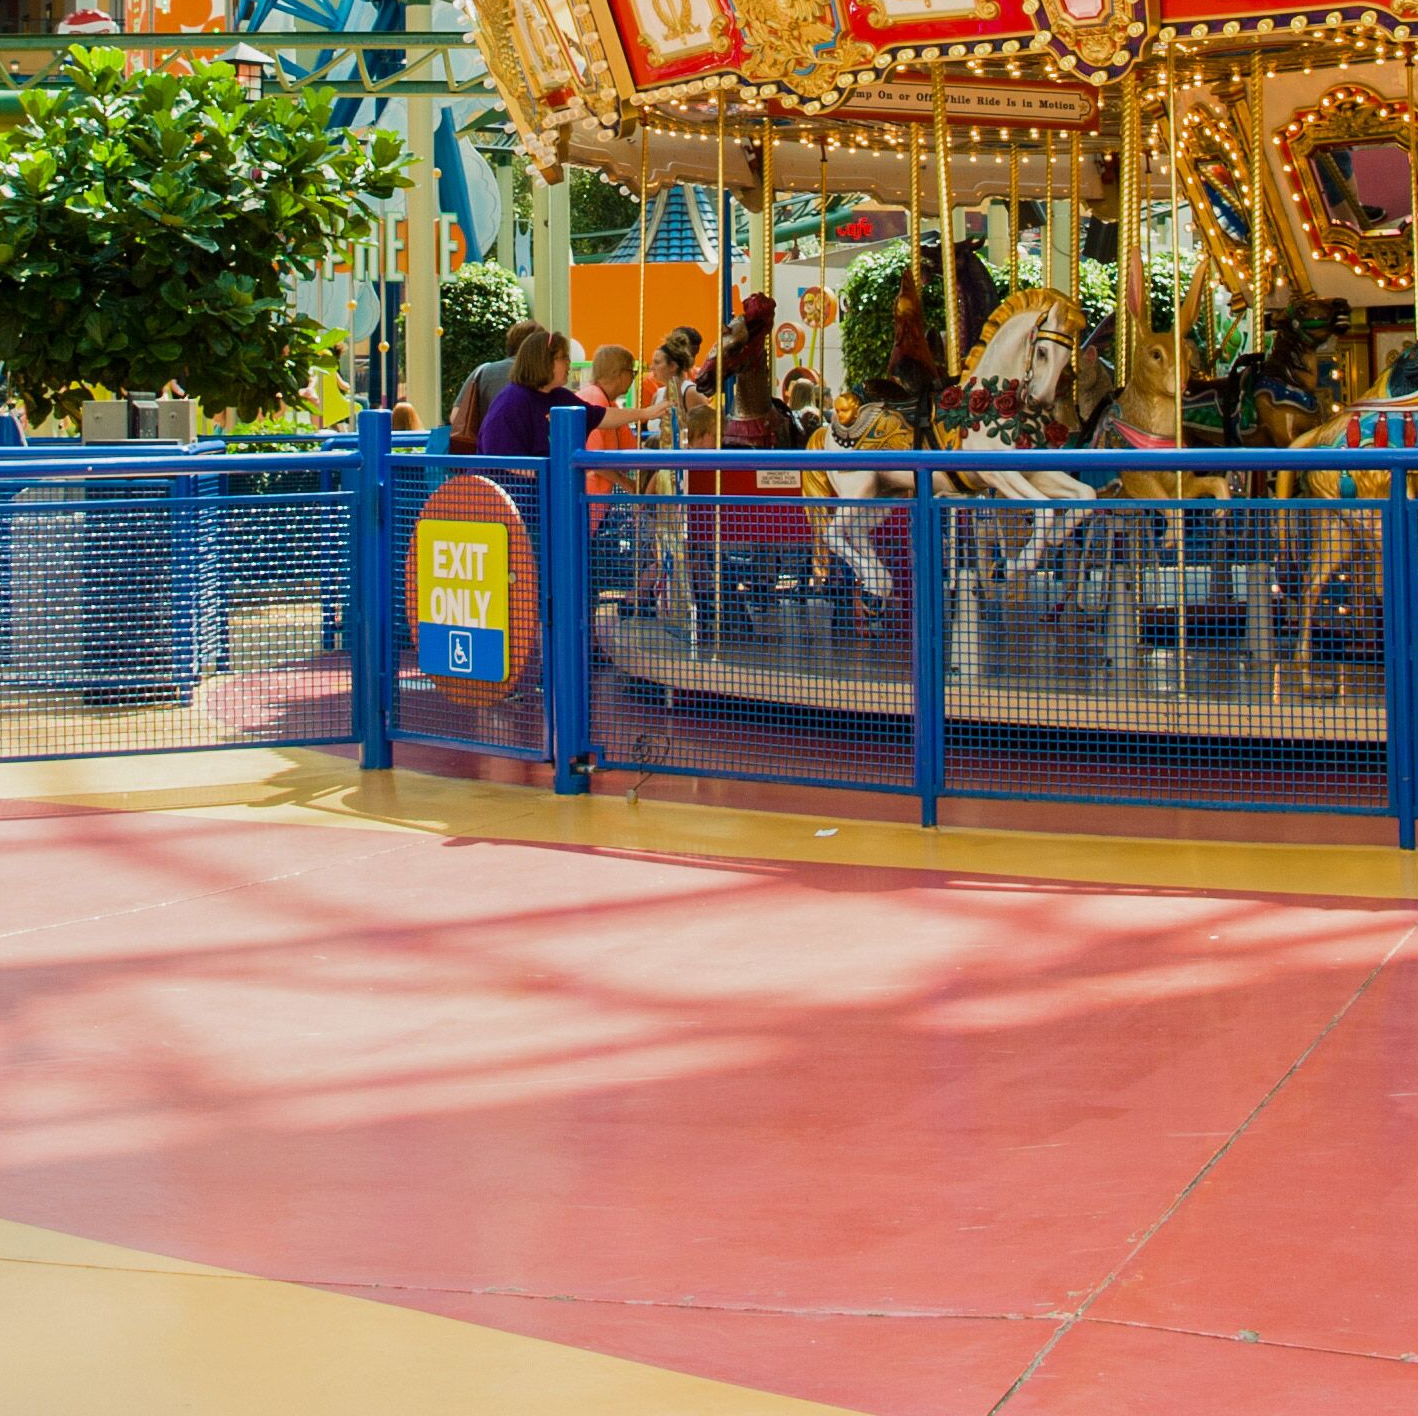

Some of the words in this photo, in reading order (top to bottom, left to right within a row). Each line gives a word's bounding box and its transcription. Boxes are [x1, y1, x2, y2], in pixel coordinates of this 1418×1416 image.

[878, 89, 893, 100] On
[898, 92, 911, 101] or
[977, 96, 1001, 106] Ride
[1006, 97, 1017, 107] Is
[1022, 97, 1033, 108] in
[1039, 99, 1076, 110] Motion
[432, 540, 489, 581] EXIT
[430, 587, 492, 629] ONLY
